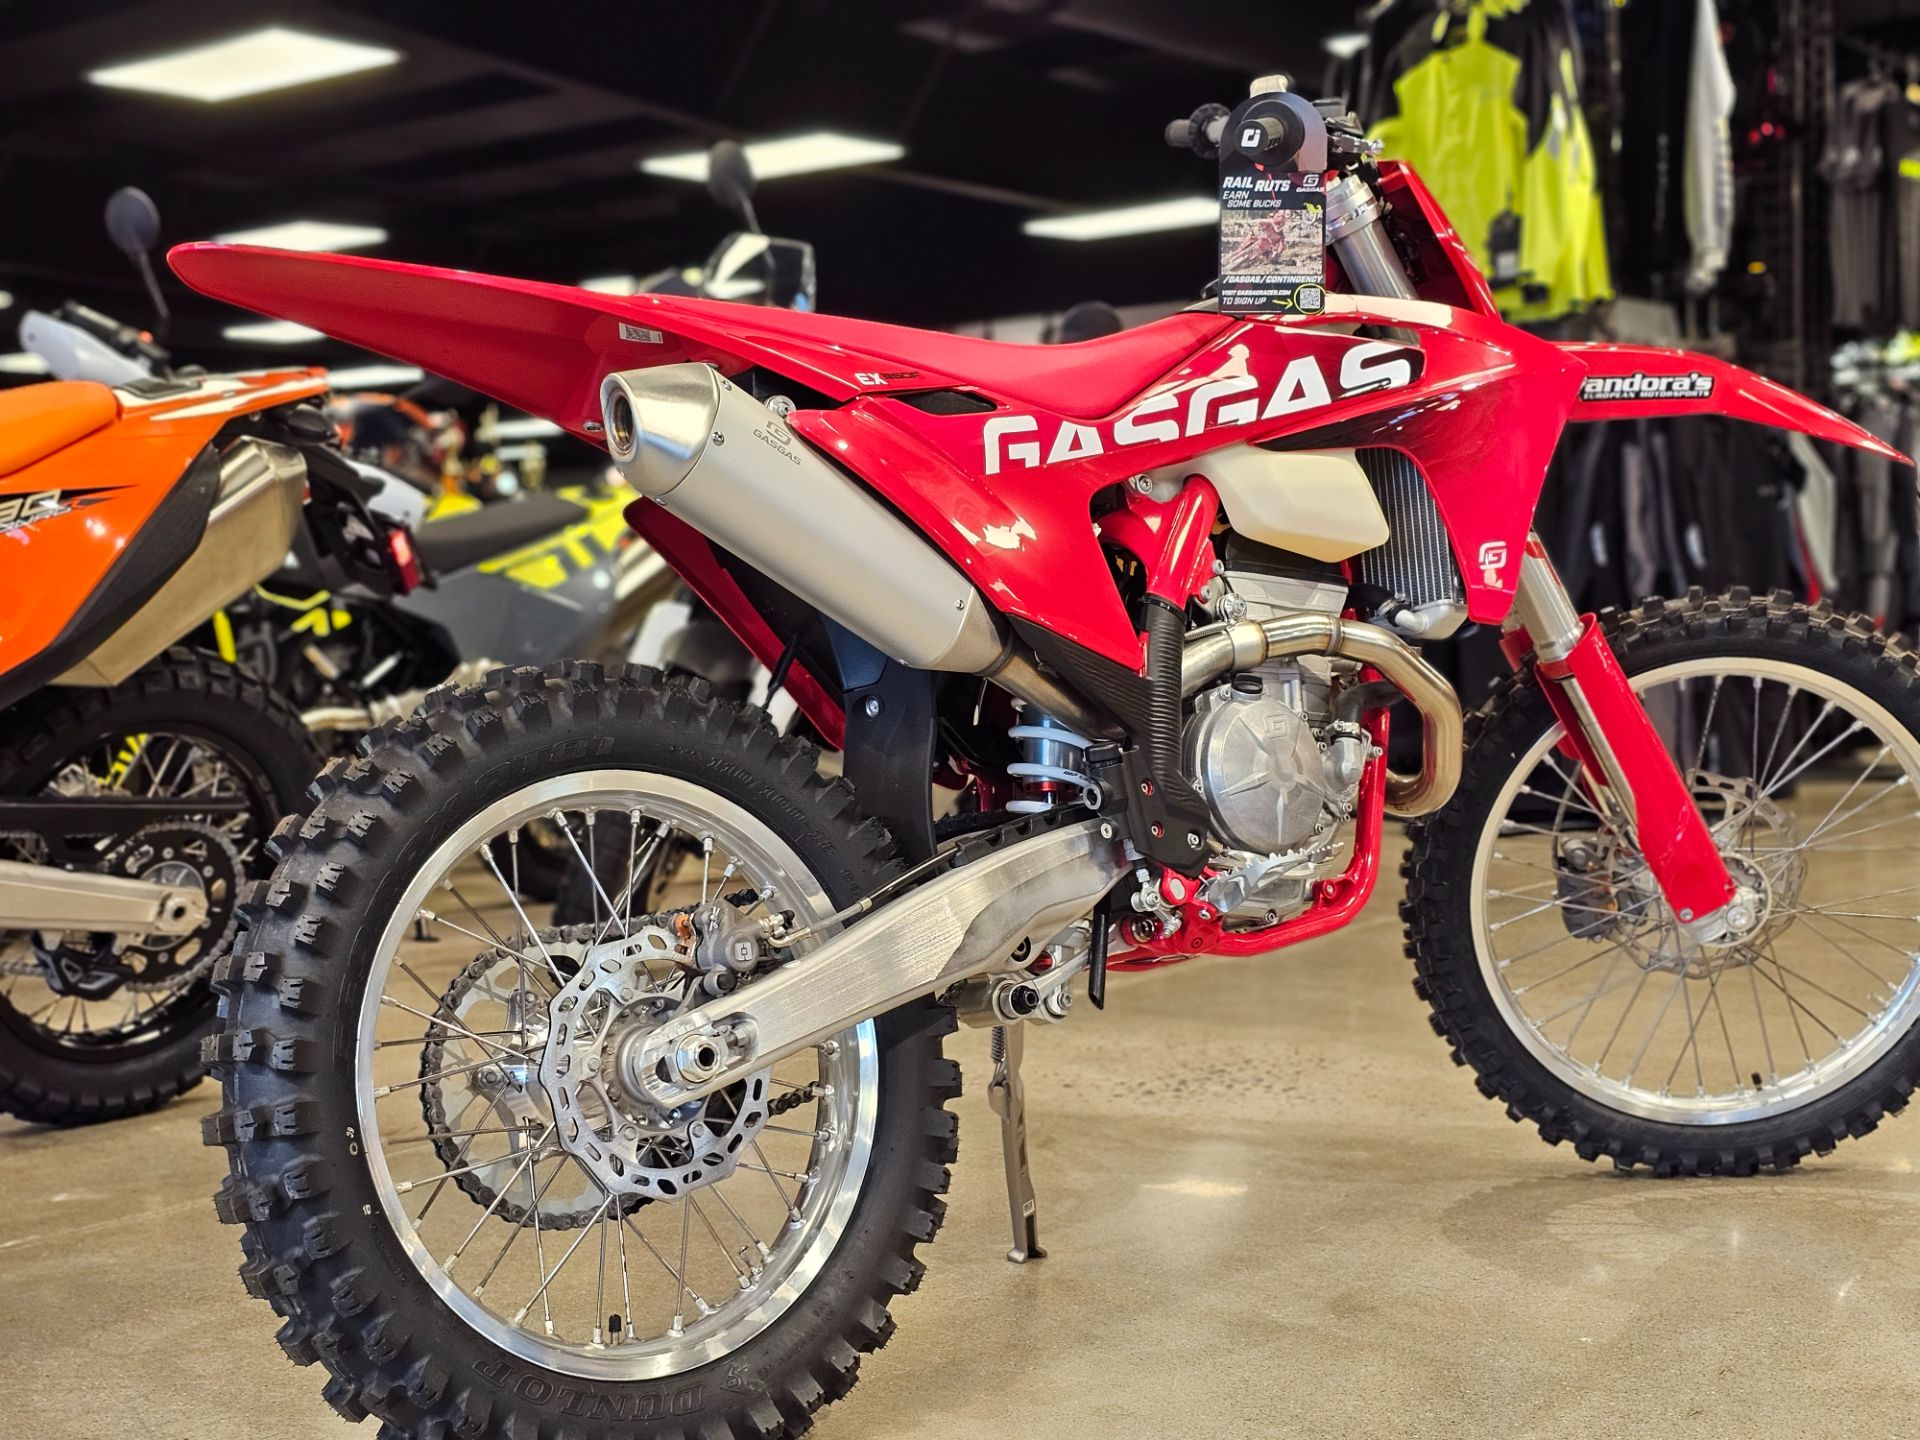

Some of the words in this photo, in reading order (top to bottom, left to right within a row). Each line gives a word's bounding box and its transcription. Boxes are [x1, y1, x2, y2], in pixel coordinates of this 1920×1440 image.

[1222, 176, 1253, 188] RAIL
[1254, 179, 1291, 192] RUTS
[1222, 190, 1250, 200] EARN
[1227, 199, 1252, 208] SOME
[1252, 199, 1282, 208] BUCKS
[1222, 296, 1232, 305] TO
[1233, 296, 1254, 305] SIGN
[1254, 296, 1267, 305] UP
[854, 372, 888, 386] EX
[1580, 373, 1713, 392] andora's
[1583, 391, 1636, 400] EUROPEAN
[1640, 390, 1711, 398] MOTORSPORTS
[983, 341, 1411, 475] GASGAS
[752, 428, 802, 465] GASGAS
[472, 1359, 707, 1422] DUNLOP
